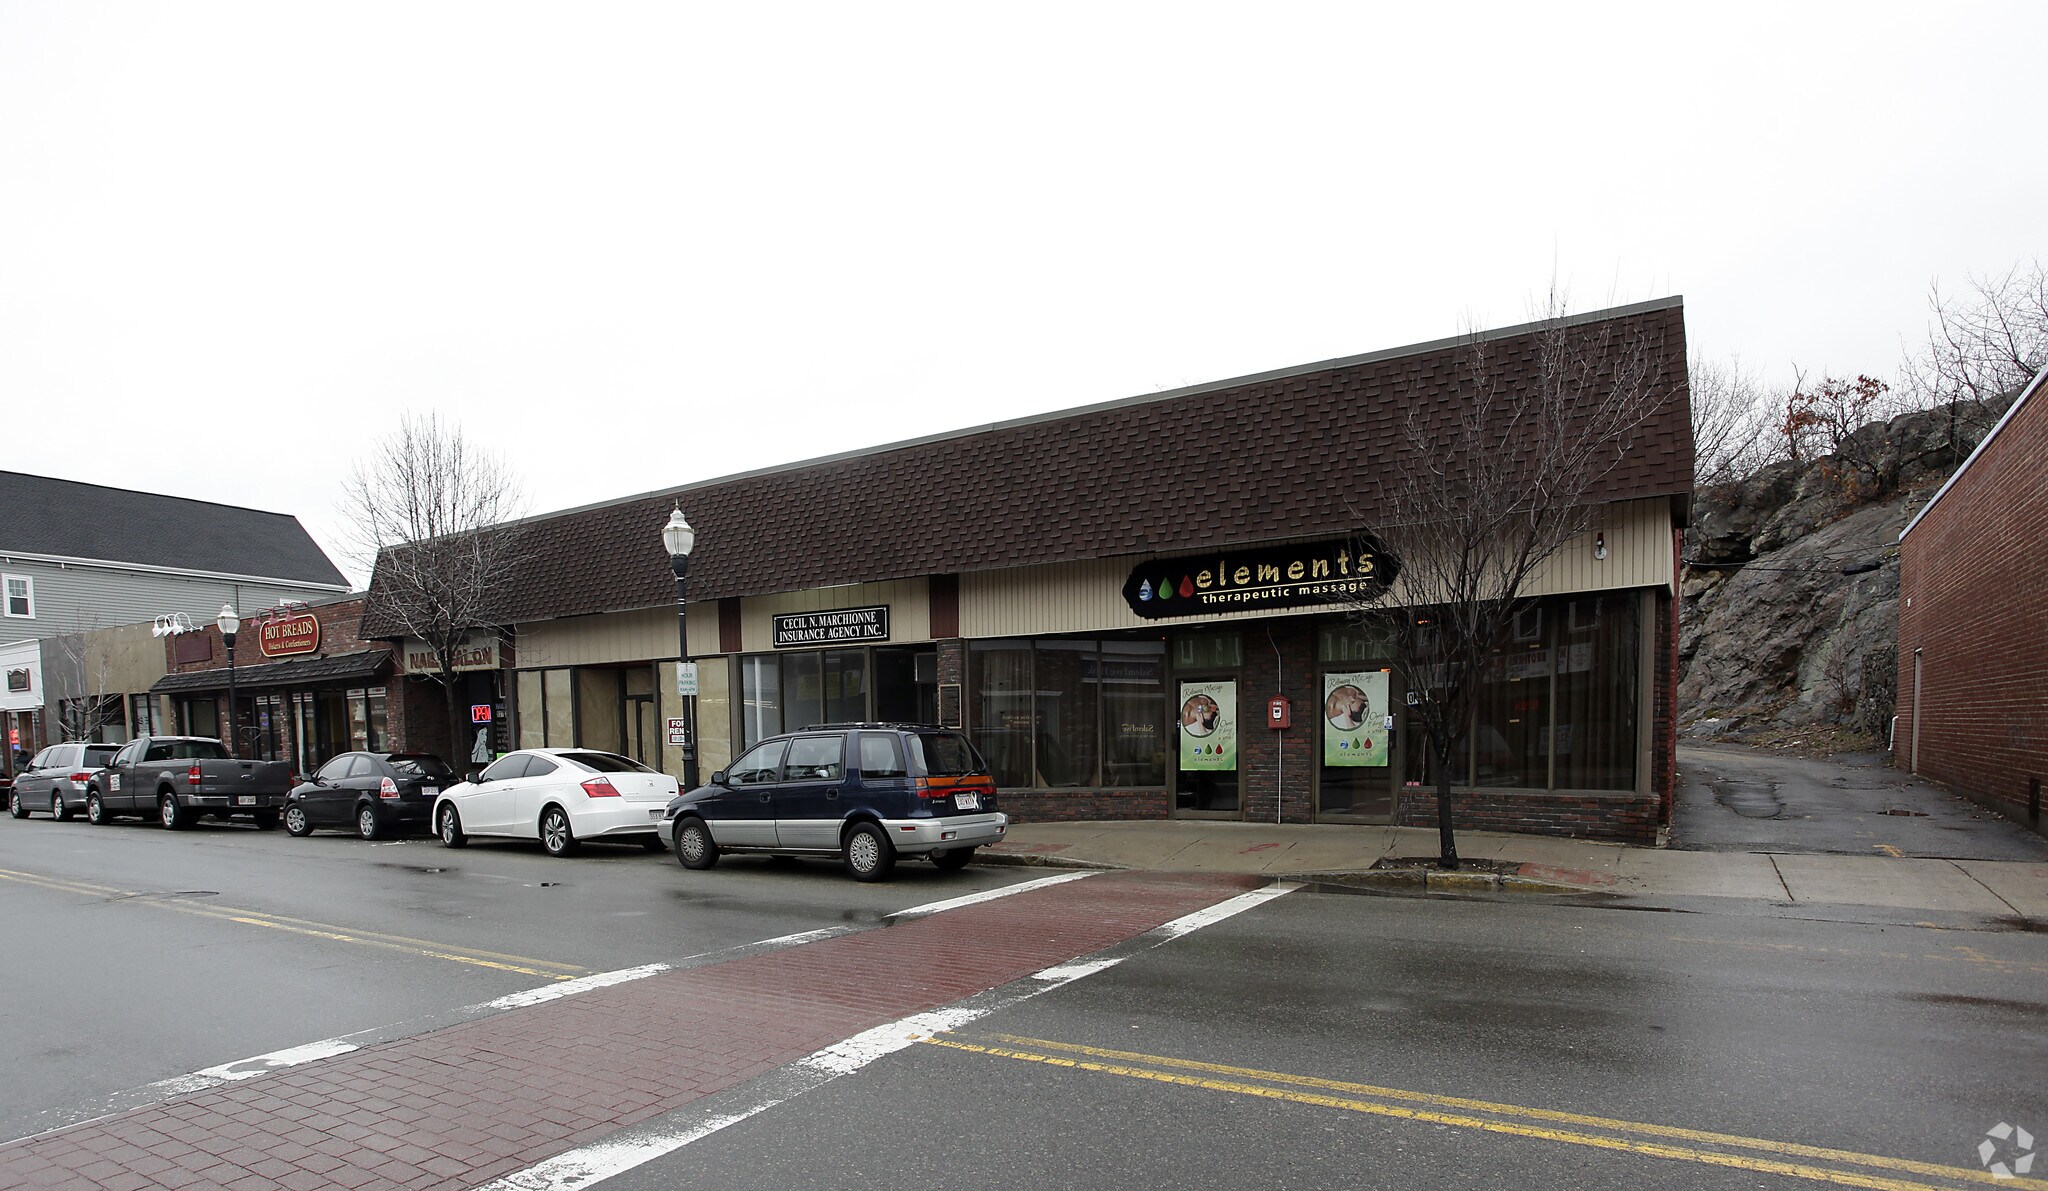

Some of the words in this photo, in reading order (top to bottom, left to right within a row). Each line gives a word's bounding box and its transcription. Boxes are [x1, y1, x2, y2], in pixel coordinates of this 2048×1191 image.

[1196, 549, 1374, 589] elements
[1202, 586, 1290, 604] therapeutic
[1298, 580, 1367, 598] massage
[265, 626, 280, 640] HOT
[282, 620, 313, 637] BREADS
[783, 617, 807, 630] CECIL
[809, 616, 818, 627] N.
[818, 611, 877, 627] MARCHIONNE
[779, 628, 825, 642] INSURANCE
[827, 625, 861, 639] AGENCY
[864, 624, 882, 636] INC.
[473, 706, 491, 721] OPEN
